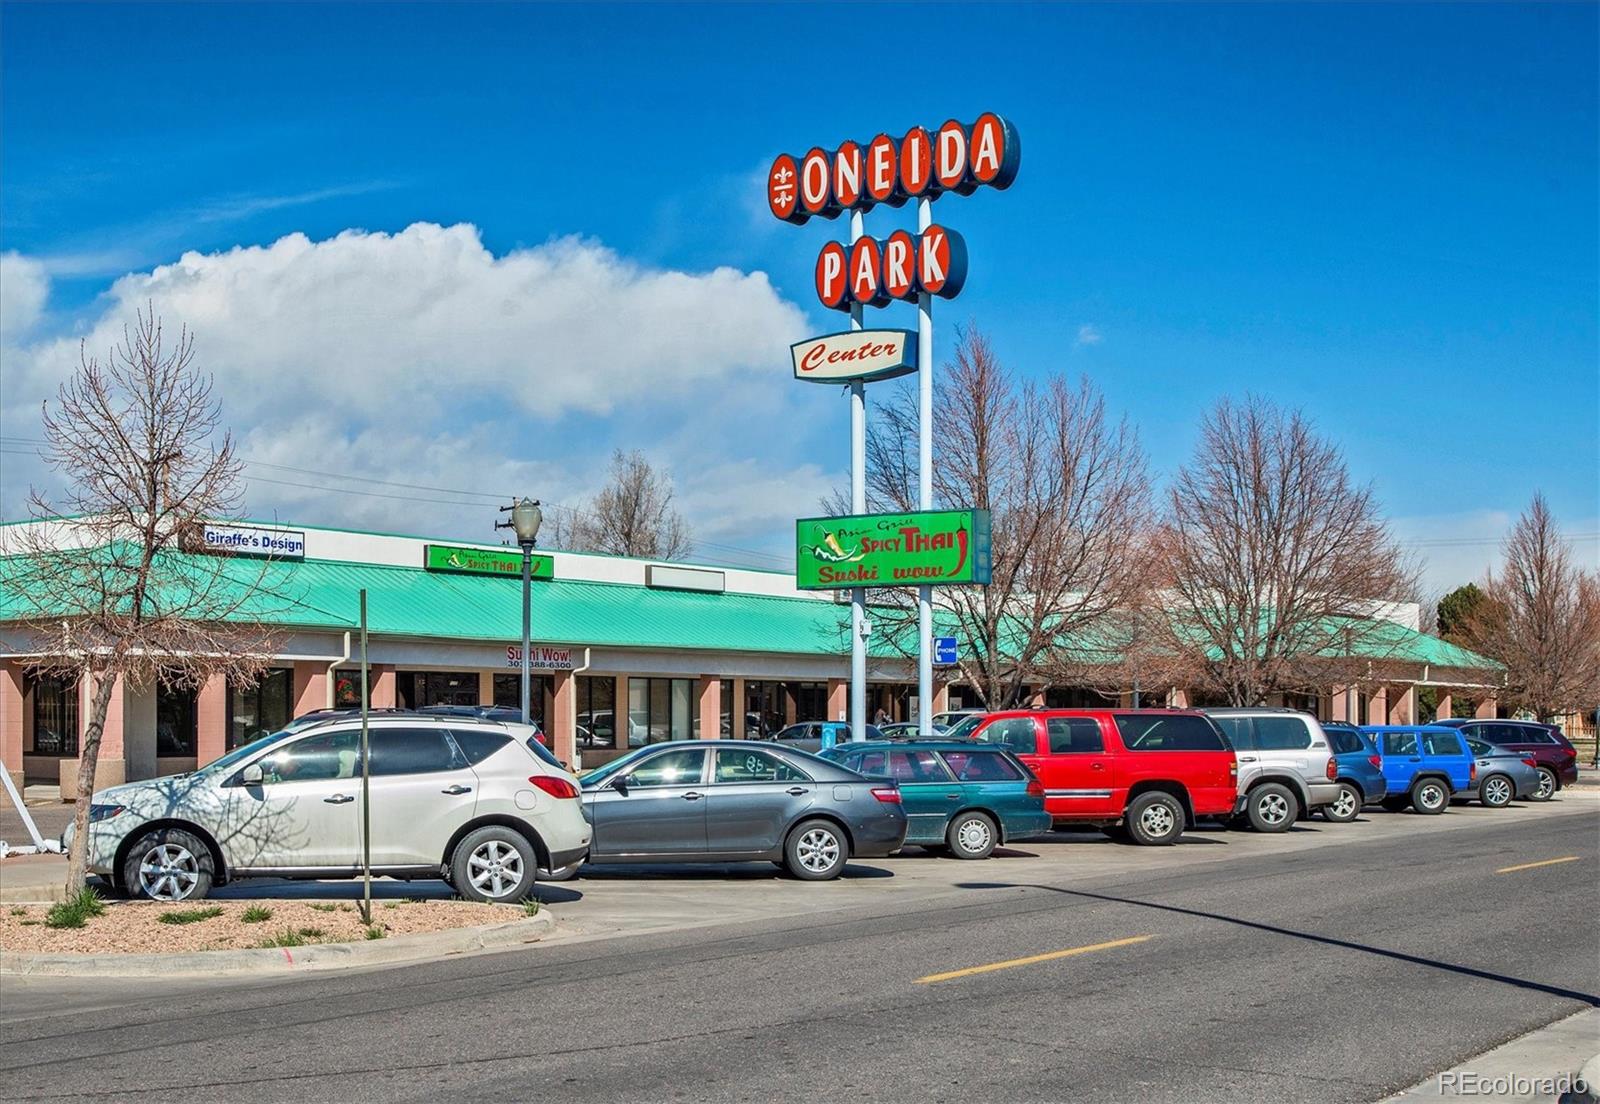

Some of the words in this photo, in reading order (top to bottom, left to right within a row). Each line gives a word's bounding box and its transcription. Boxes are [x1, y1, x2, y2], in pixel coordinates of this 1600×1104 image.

[803, 123, 999, 204] ONEIDA
[823, 233, 945, 297] PARK
[801, 341, 897, 371] Center
[206, 531, 259, 547] Giraffe's
[262, 536, 303, 552] Design
[818, 564, 879, 584] Sushi
[893, 565, 945, 579] wow
[507, 646, 539, 661] Suhi
[541, 647, 572, 662] Wow!
